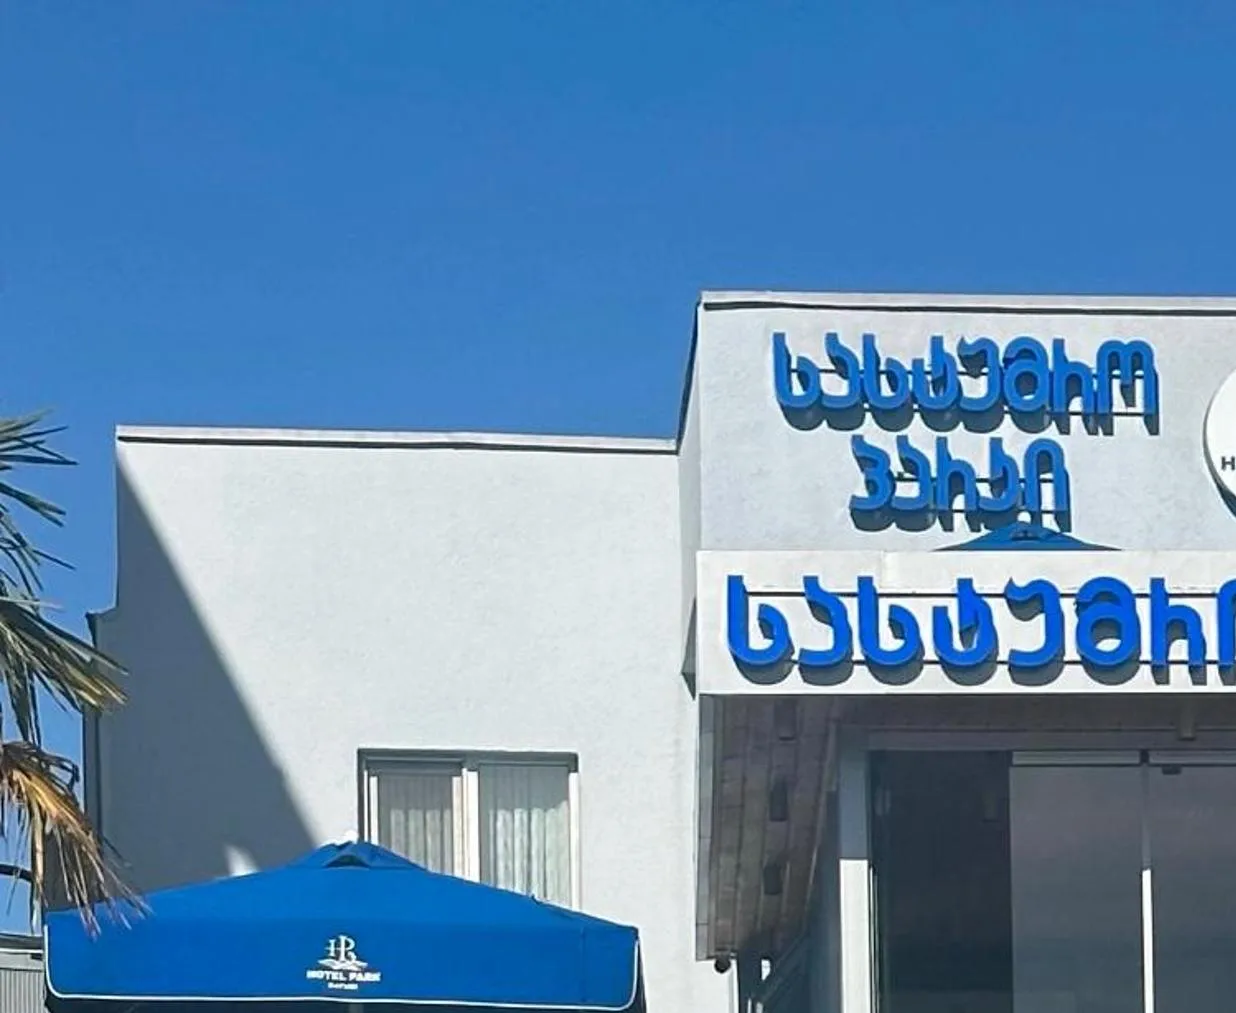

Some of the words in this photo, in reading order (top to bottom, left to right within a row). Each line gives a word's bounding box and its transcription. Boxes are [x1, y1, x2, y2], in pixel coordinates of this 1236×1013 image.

[772, 333, 1158, 416] სასტუმრო
[850, 435, 1070, 514] პარკი
[306, 970, 347, 981] HOTEL
[348, 972, 381, 982] PARK
